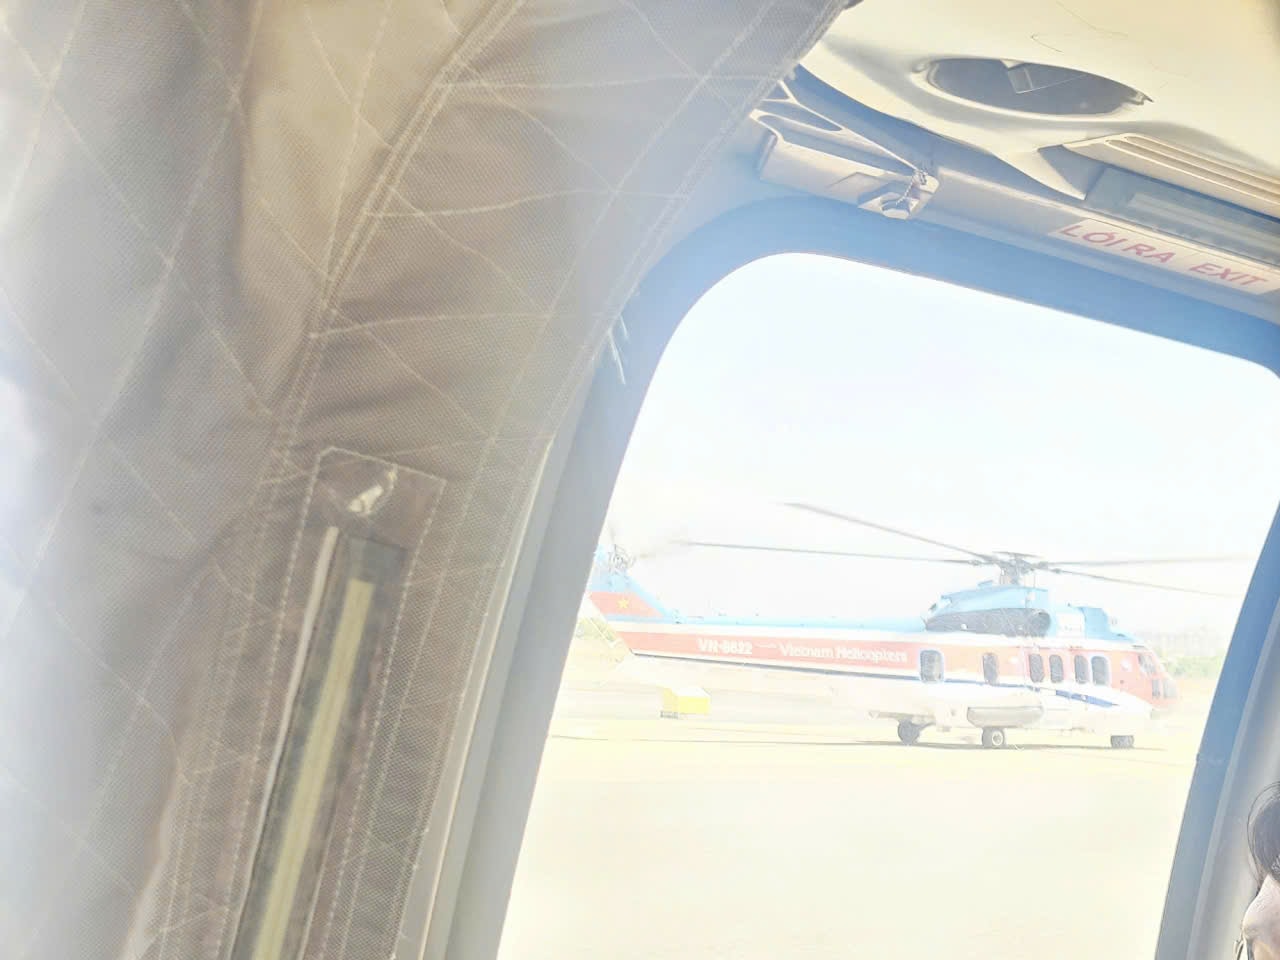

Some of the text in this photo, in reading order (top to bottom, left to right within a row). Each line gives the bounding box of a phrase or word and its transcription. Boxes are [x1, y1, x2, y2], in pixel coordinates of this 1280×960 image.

[1121, 243, 1177, 263] RA
[1189, 262, 1269, 286] EXIT
[778, 643, 834, 659] Vietnam
